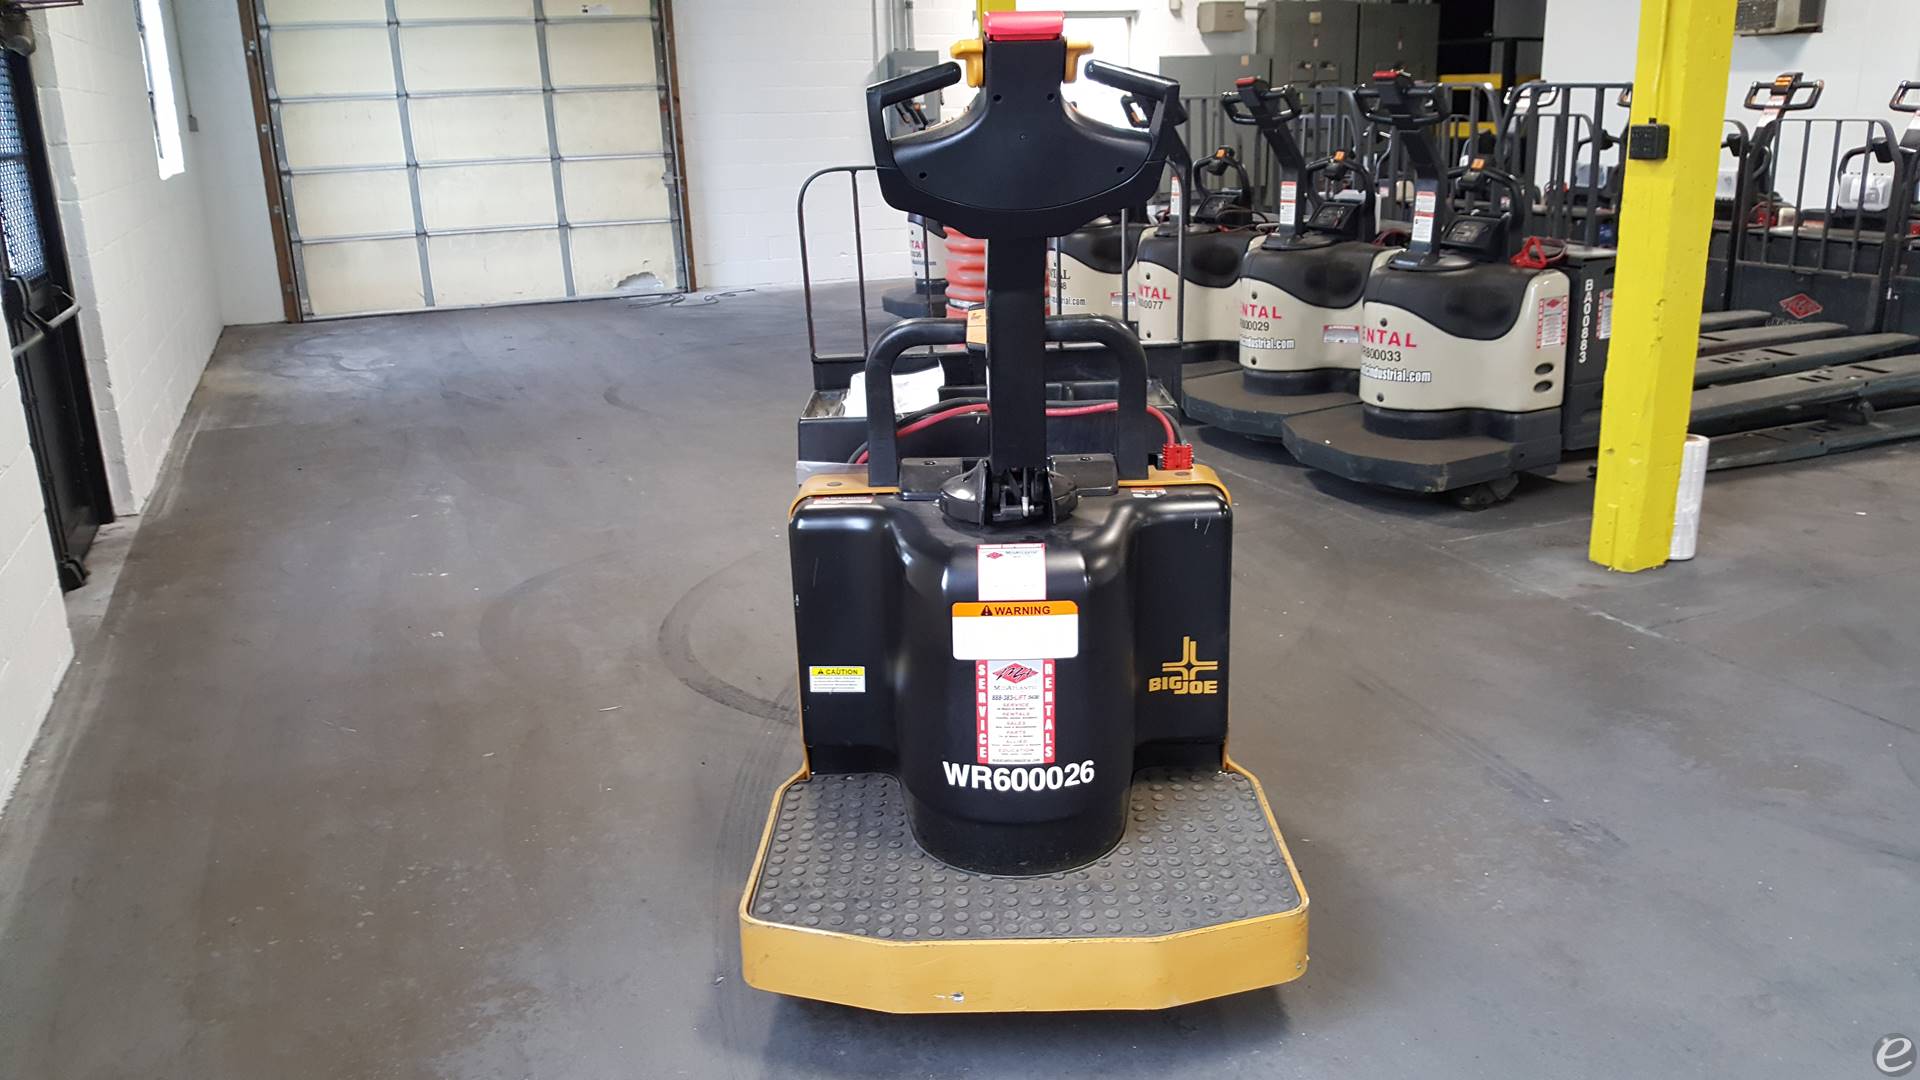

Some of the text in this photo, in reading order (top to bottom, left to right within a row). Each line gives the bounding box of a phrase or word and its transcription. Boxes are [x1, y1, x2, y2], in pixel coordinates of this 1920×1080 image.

[1578, 278, 1594, 364] BA00883
[994, 605, 1051, 616] WARNING
[978, 664, 988, 758] SERVICE
[1044, 663, 1053, 758] RENTALS
[1148, 676, 1218, 695] BIG JOE
[942, 759, 1096, 792] WR600026
